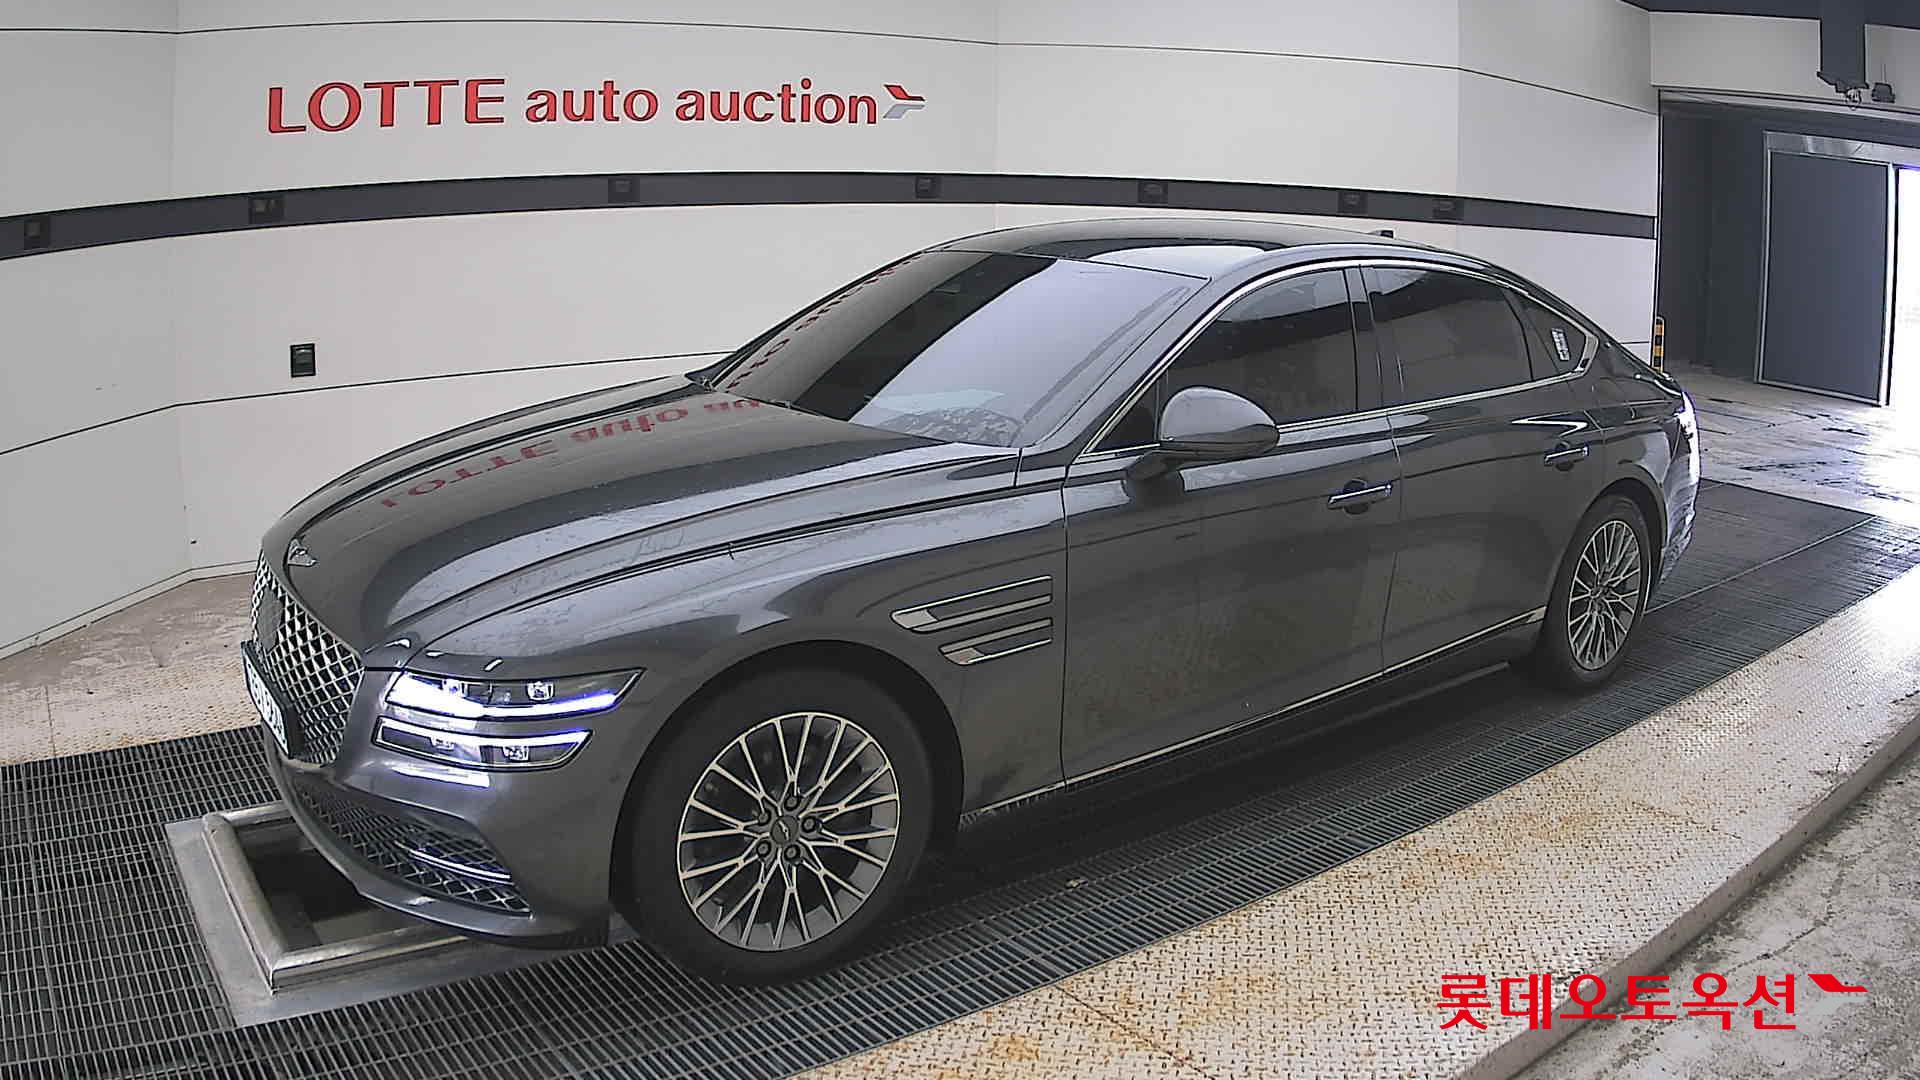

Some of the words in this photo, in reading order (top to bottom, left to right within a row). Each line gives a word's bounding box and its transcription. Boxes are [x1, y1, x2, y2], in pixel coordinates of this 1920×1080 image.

[266, 79, 505, 134] LOTTE
[526, 80, 658, 122] auto
[675, 78, 878, 123] auction
